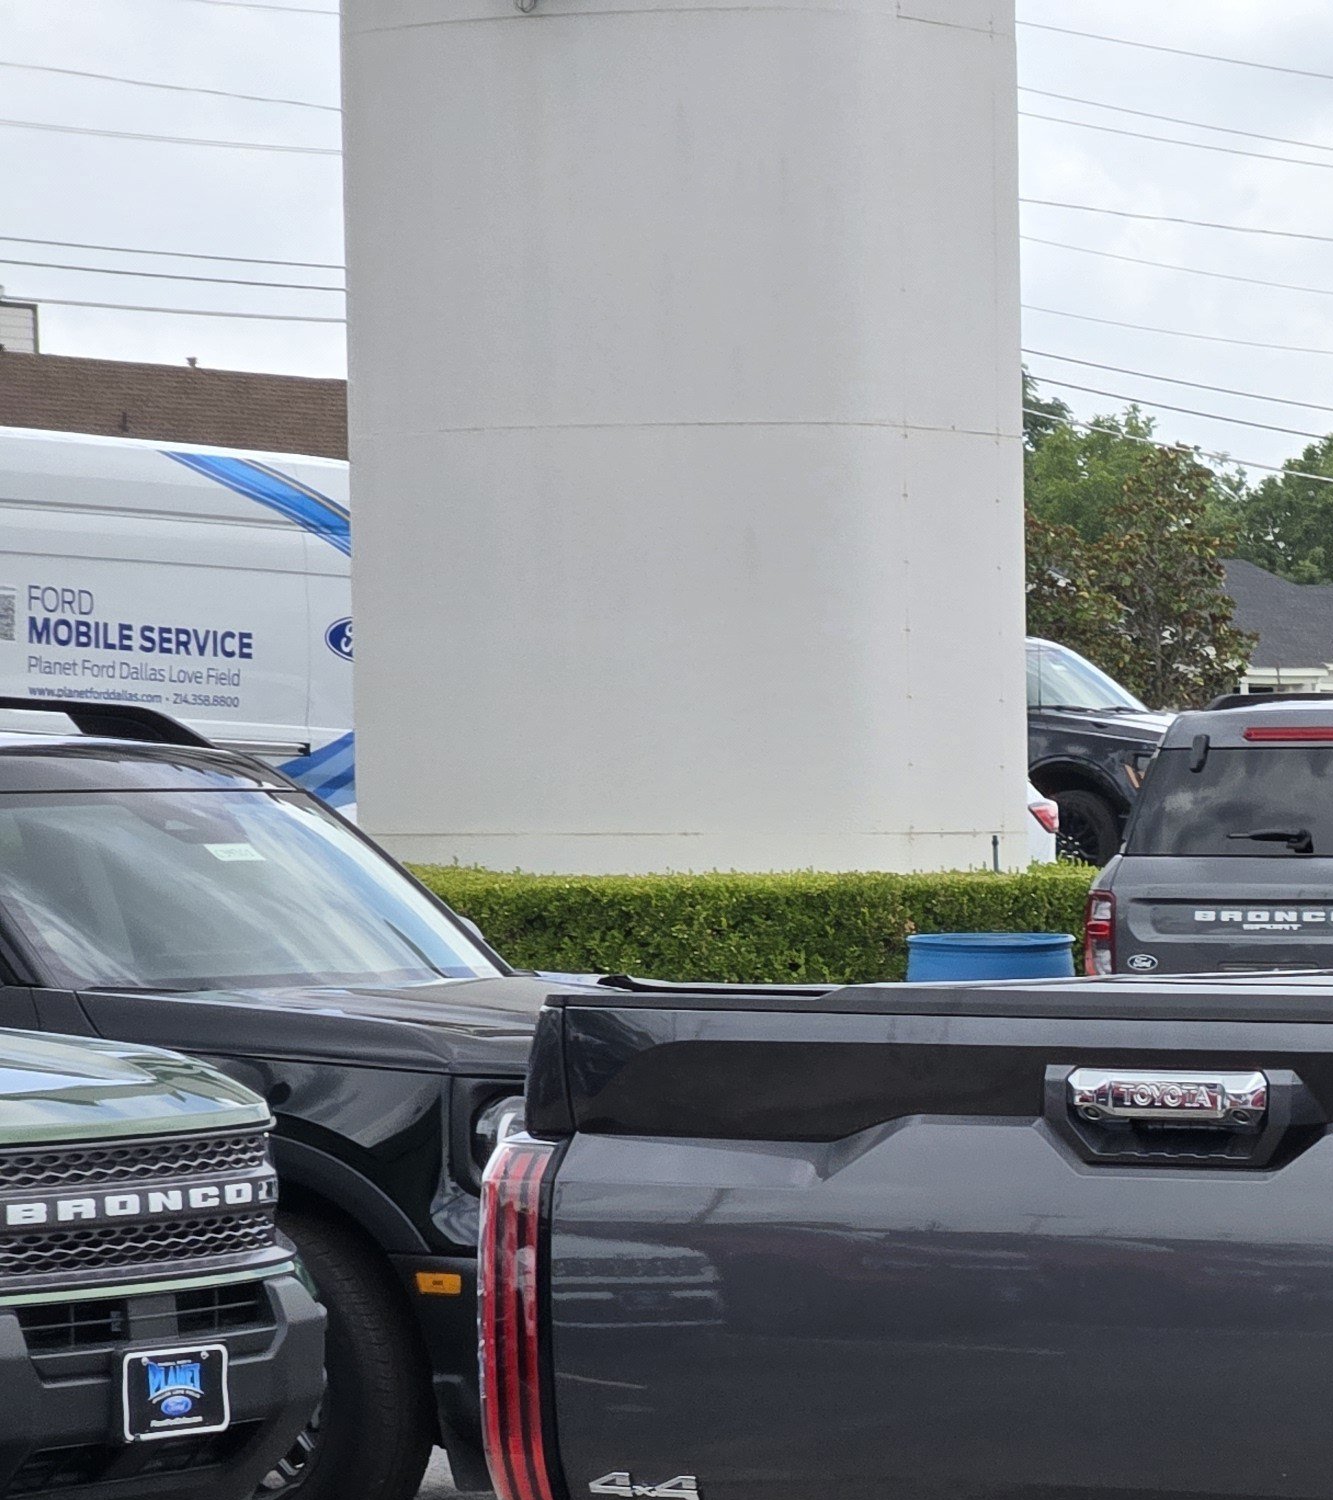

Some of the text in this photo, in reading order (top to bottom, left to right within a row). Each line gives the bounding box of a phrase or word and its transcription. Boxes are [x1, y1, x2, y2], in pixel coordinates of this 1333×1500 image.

[28, 584, 95, 616] FORD
[28, 616, 254, 660] MOBILE SERVICE
[27, 655, 241, 687] Planet Ford Dallas Love Field
[1118, 1082, 1213, 1108] TOYOTA
[6, 1182, 253, 1226] BRONCO
[588, 1471, 700, 1500] 4x4
